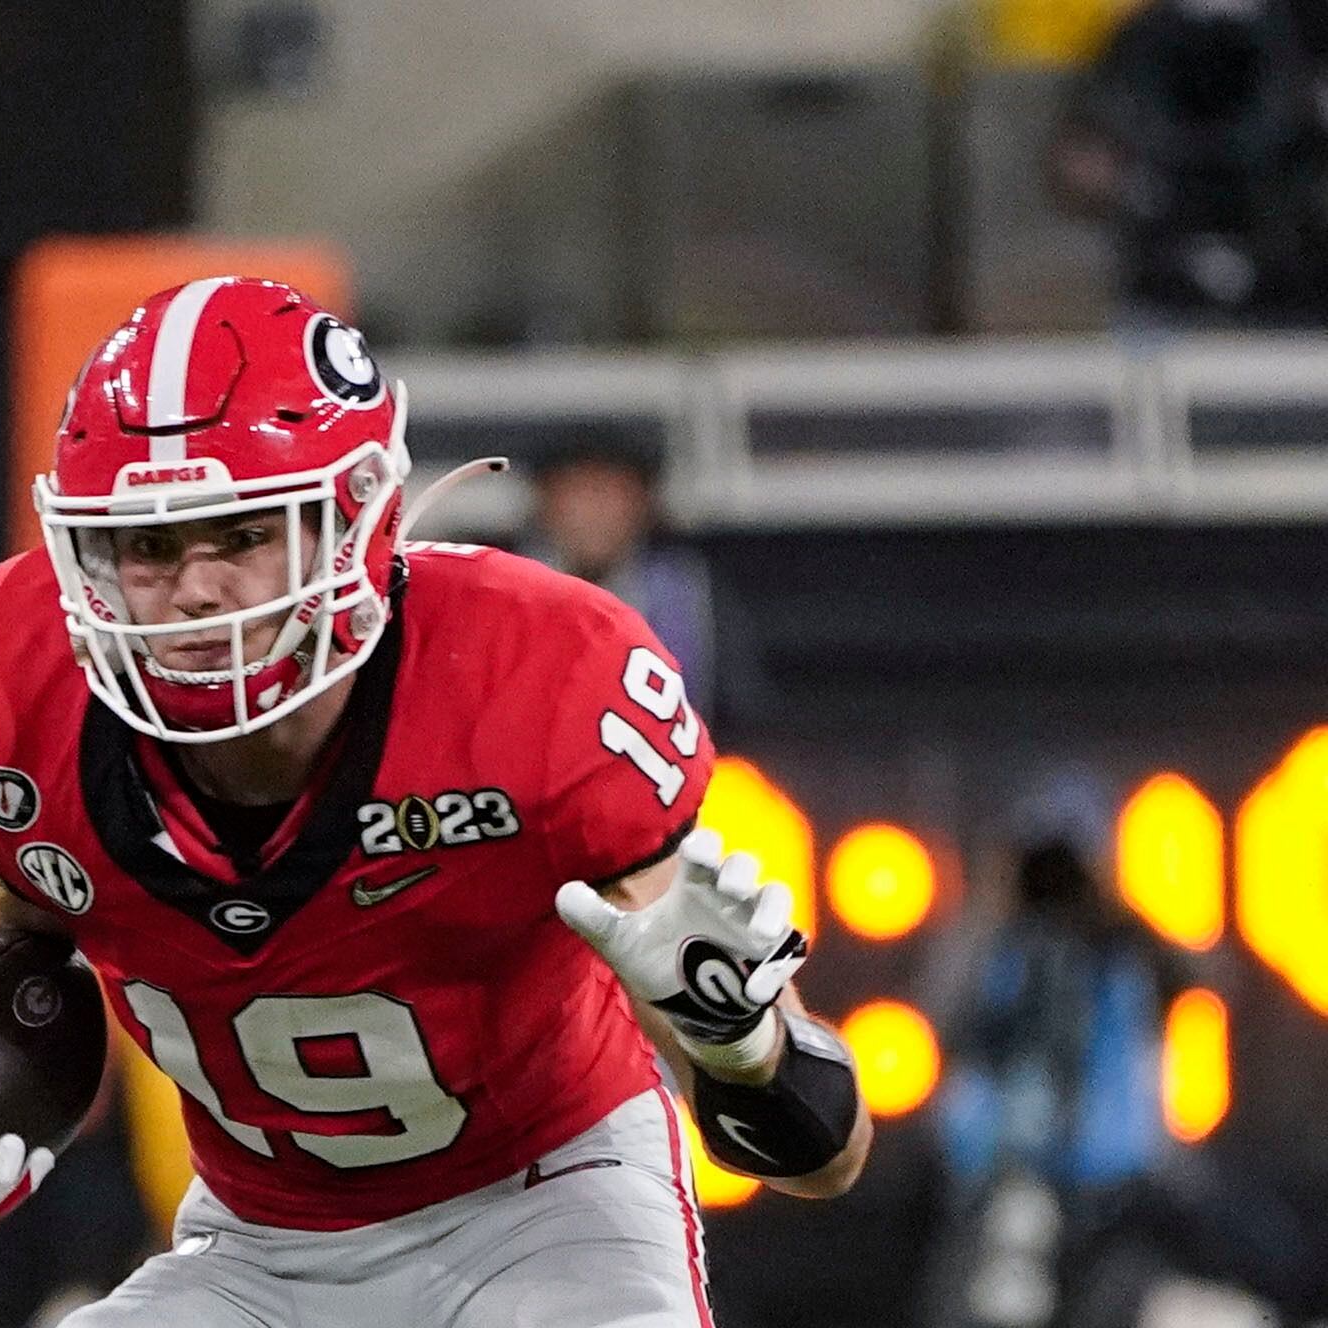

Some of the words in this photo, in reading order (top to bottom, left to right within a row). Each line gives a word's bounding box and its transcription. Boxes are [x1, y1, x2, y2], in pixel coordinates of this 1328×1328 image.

[127, 466, 207, 487] DAWGS
[599, 646, 701, 808] 19
[22, 849, 88, 912] SEC
[123, 980, 469, 1169] 19
